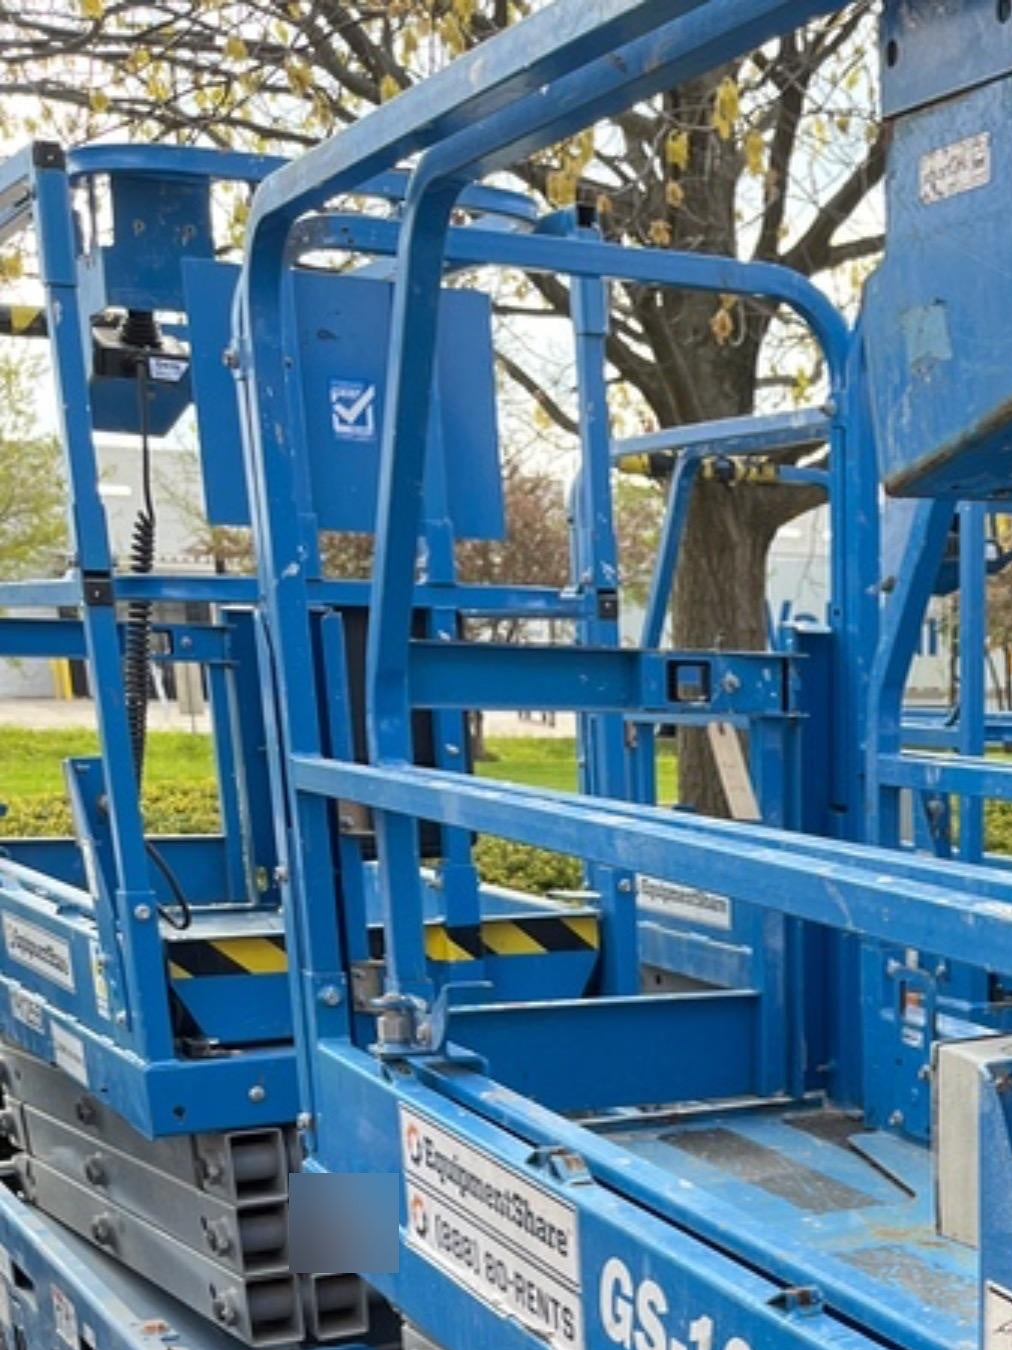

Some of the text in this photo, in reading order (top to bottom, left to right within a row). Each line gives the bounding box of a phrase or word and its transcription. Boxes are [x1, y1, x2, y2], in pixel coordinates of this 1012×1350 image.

[423, 1134, 569, 1258] EquipmentShare
[434, 1212, 576, 1342] (888) 80-RENTS
